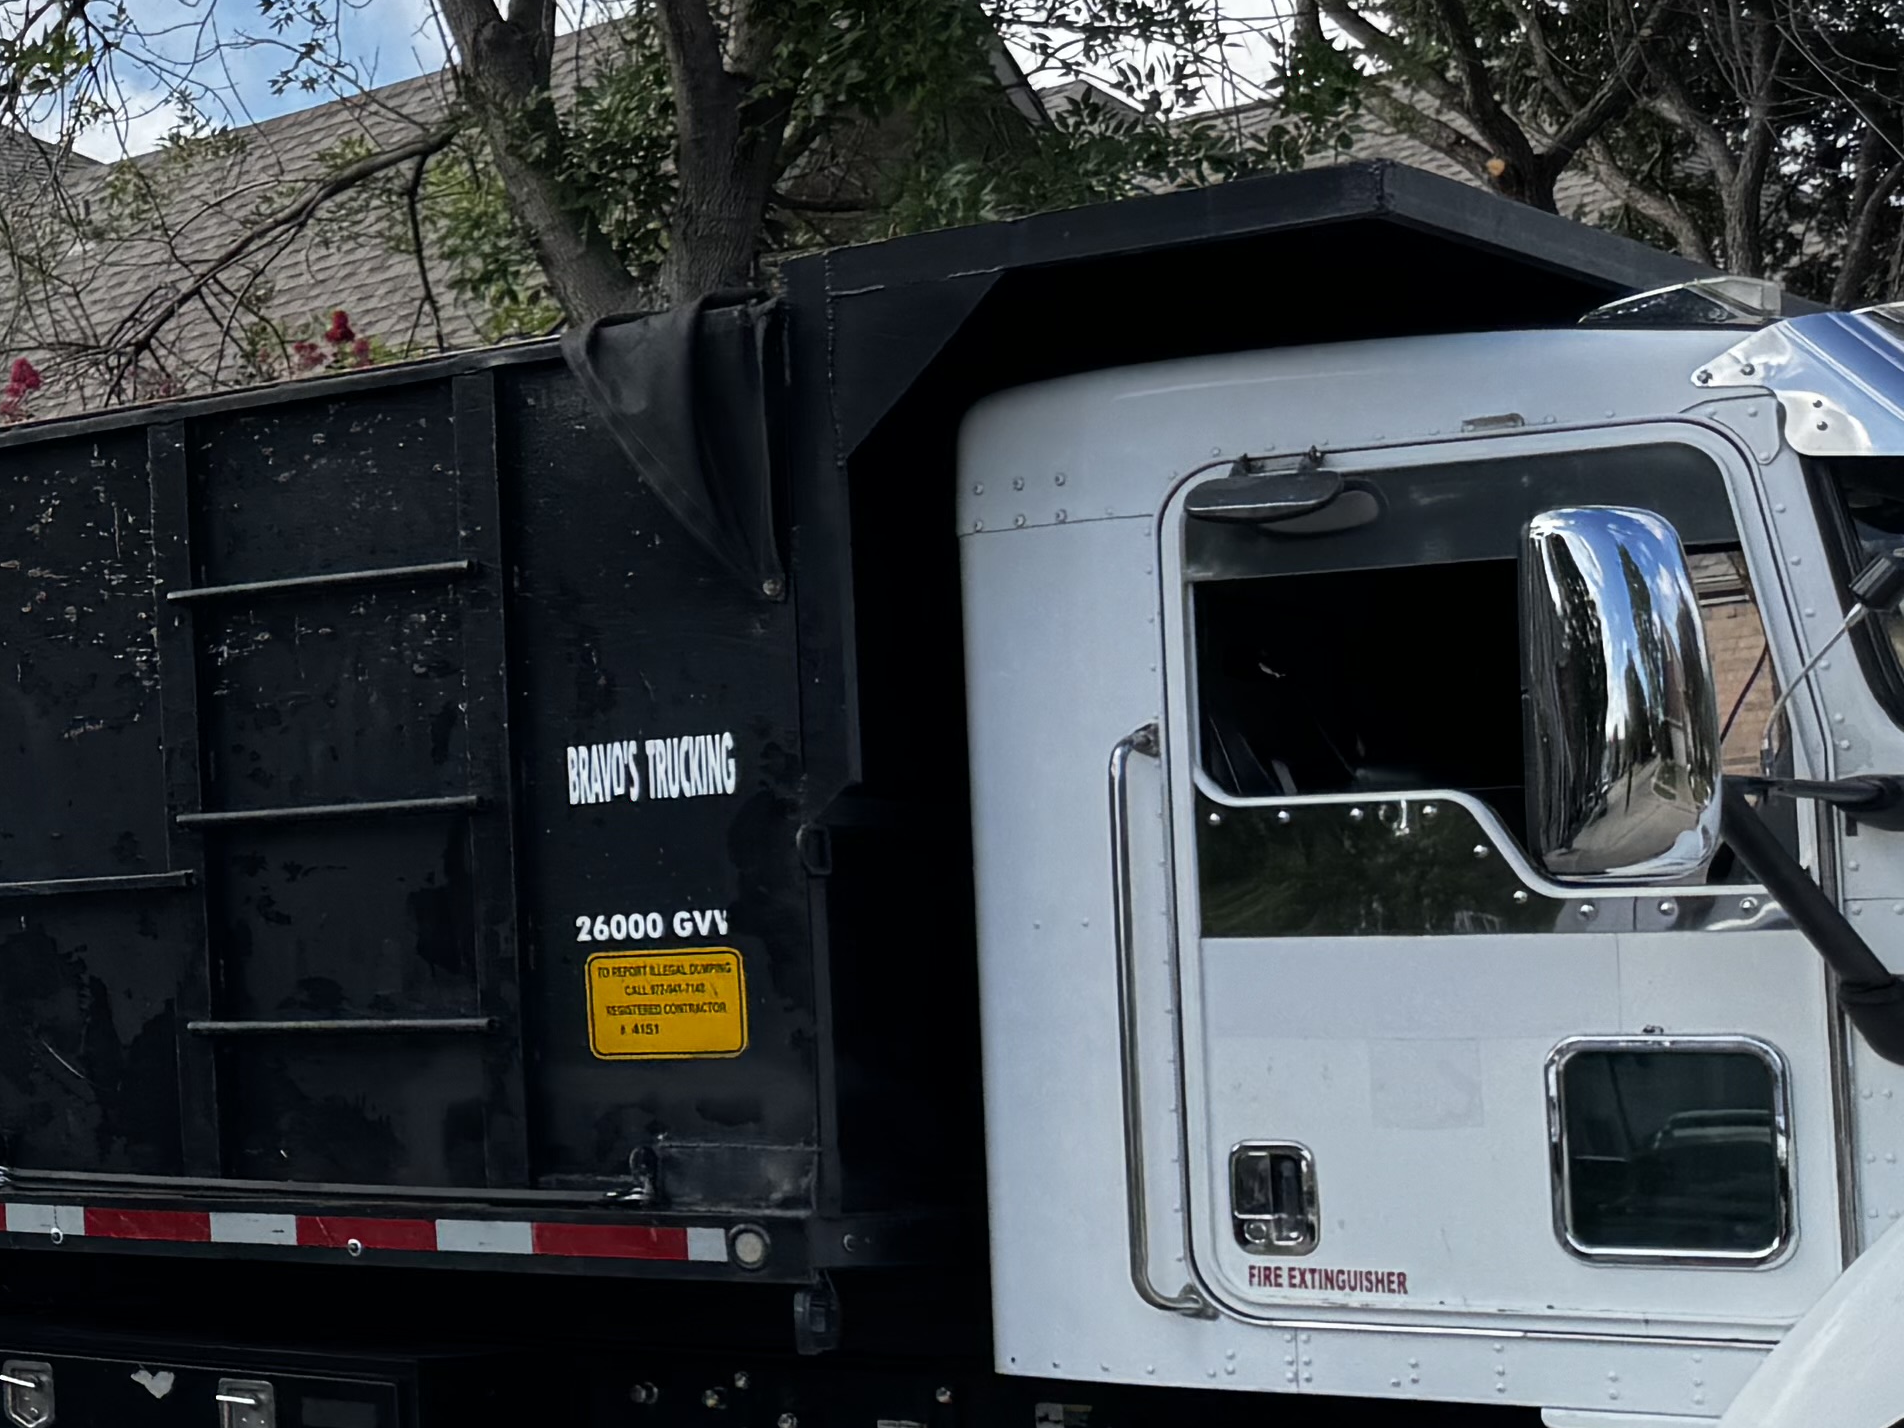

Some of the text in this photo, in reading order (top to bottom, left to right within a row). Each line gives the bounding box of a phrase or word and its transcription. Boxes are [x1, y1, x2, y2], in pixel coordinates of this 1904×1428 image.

[567, 732, 736, 805] BRAVO'S TRUCKING
[576, 912, 664, 942] 26000
[598, 967, 610, 978] TO
[625, 985, 647, 996] CALL
[664, 1002, 727, 1015] CONTRACTOR
[1248, 1265, 1408, 1295] FIRE EXTINGUISHER
